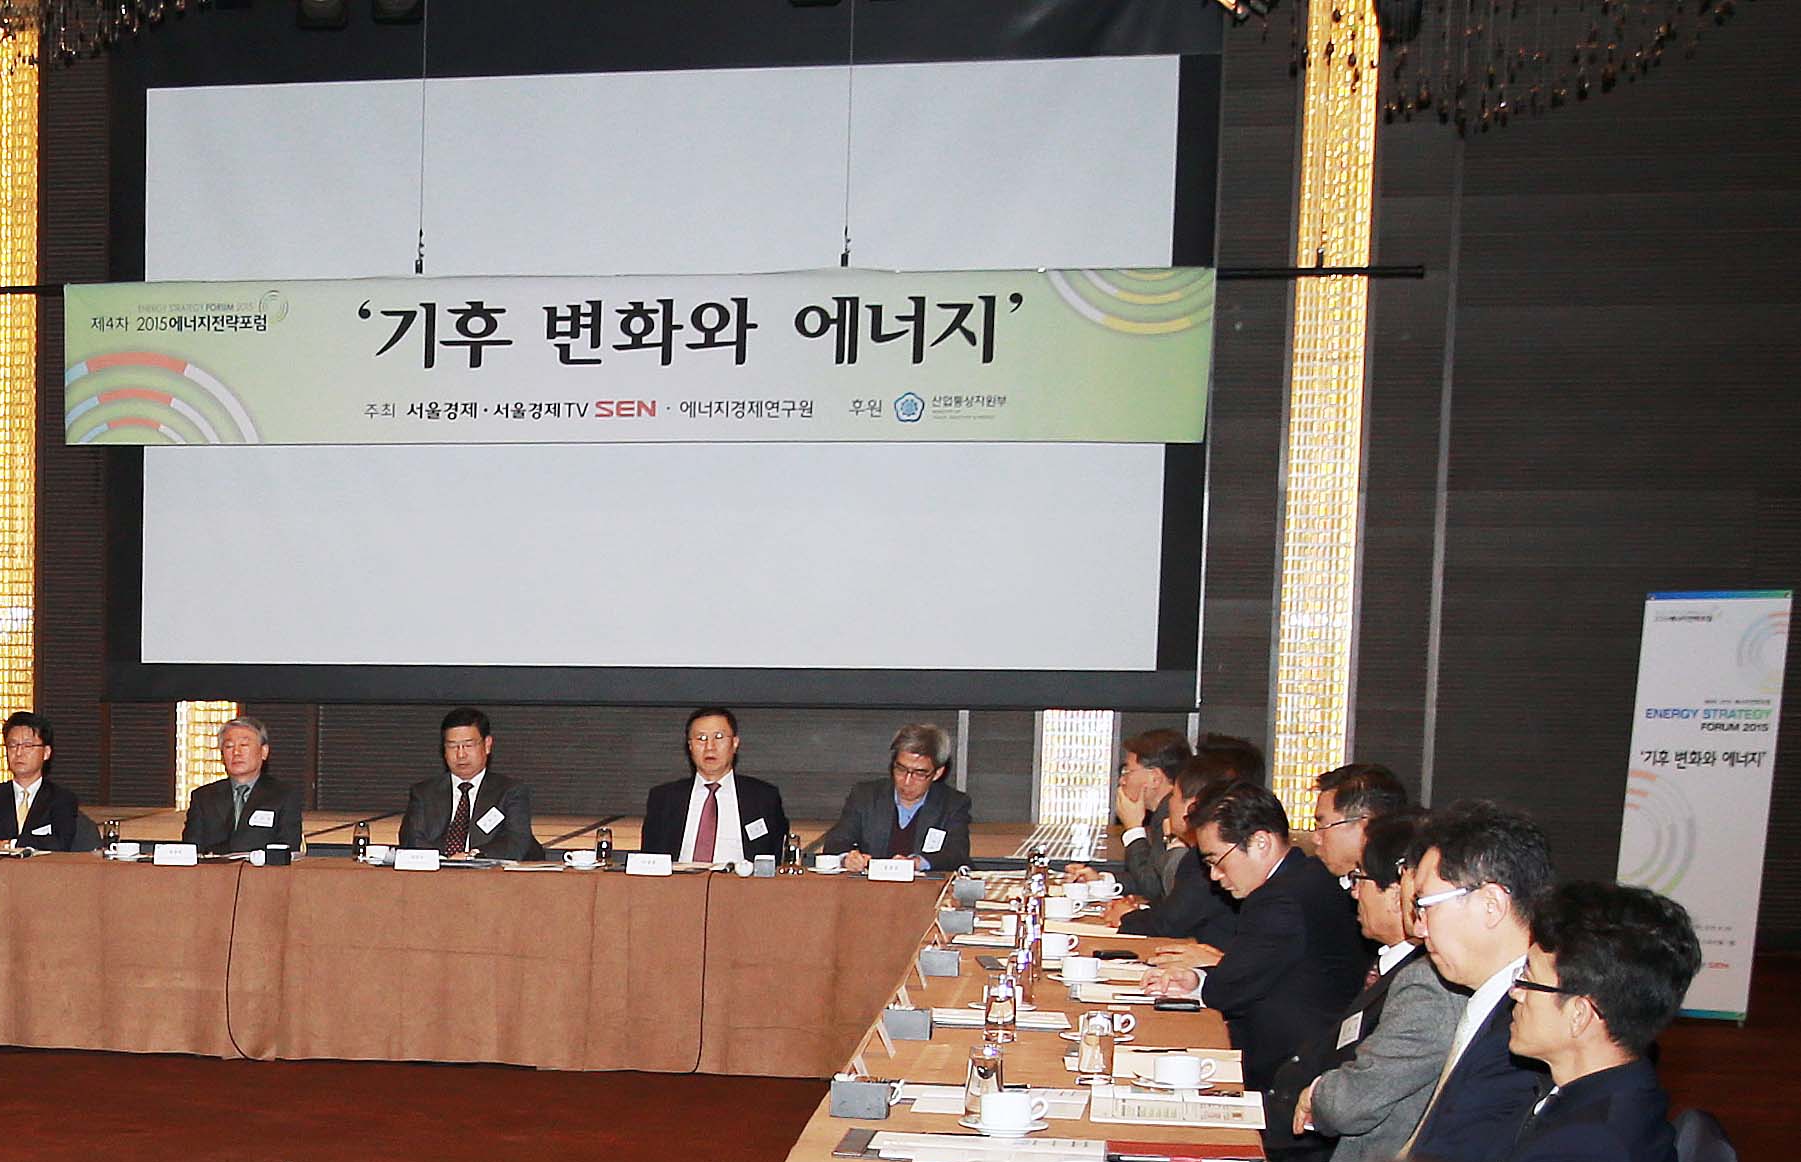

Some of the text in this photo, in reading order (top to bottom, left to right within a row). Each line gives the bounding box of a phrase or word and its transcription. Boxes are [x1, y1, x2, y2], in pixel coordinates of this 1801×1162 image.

[205, 303, 234, 312] FORUM
[90, 314, 267, 333] 제4차 2015에너지전략포럼
[357, 292, 1024, 369] ‘기후 변화와 에너지’
[363, 402, 396, 419] 주최
[594, 400, 657, 418] SEN
[679, 400, 814, 420] 에너지경제연구원
[848, 399, 882, 418] 후원
[1645, 708, 1773, 719] ENERGY STRATEGY
[1700, 722, 1770, 732] FORUM 2015
[1674, 749, 1717, 770] 변화와
